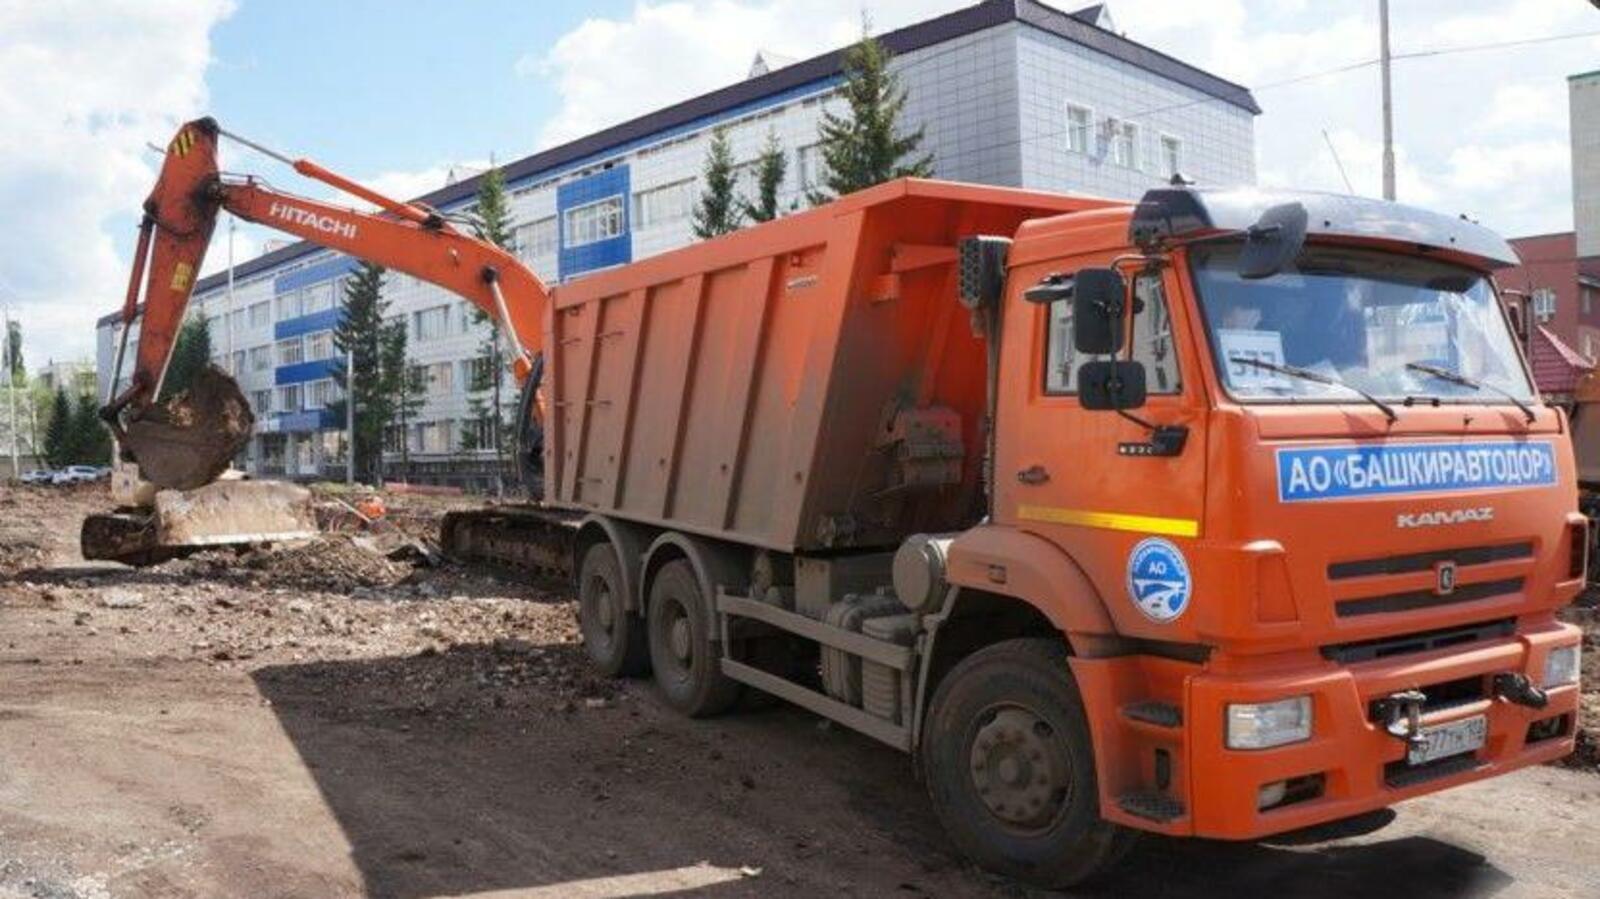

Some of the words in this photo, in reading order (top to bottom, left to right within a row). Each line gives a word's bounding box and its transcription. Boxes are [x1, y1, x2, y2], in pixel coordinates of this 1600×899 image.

[269, 201, 357, 239] HITACHI
[1288, 455, 1331, 493] АО
[1397, 507, 1495, 529] KAMAZ
